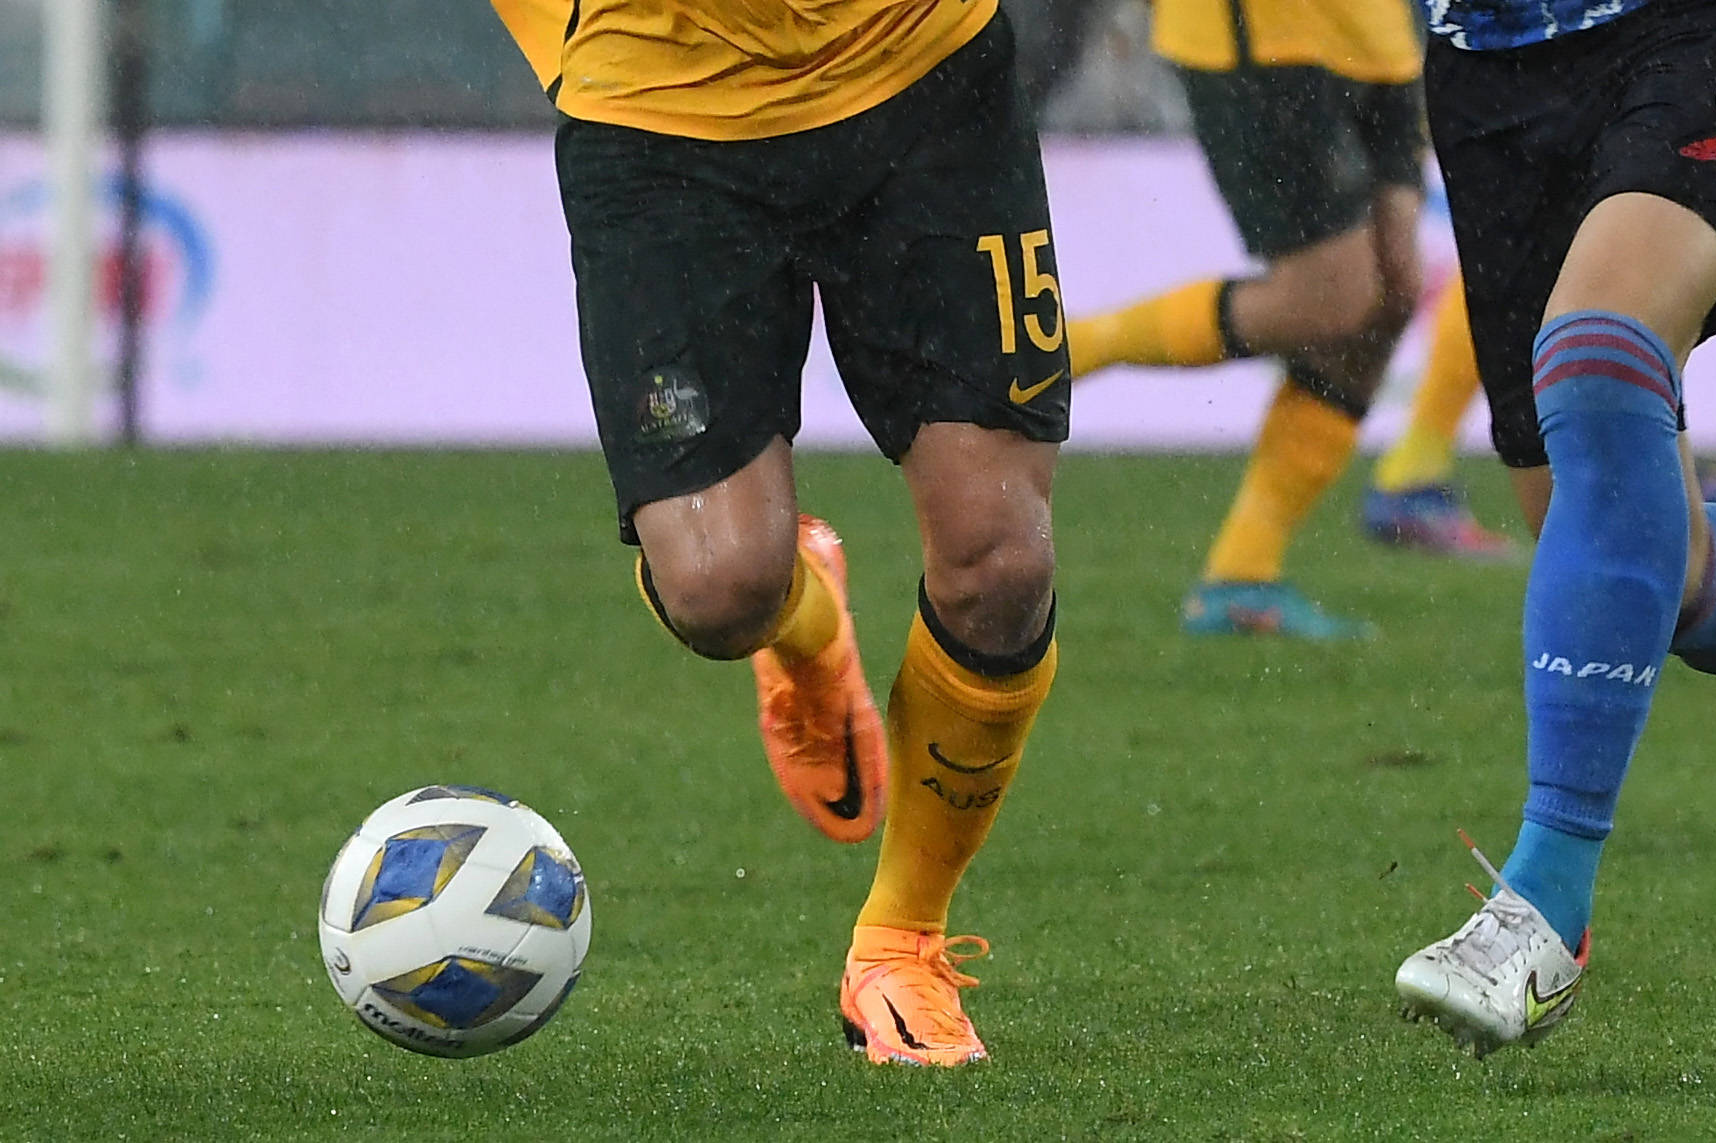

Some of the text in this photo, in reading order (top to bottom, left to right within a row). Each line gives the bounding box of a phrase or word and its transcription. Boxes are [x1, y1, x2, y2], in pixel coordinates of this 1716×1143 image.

[976, 229, 1063, 353] 15
[1532, 652, 1657, 687] JAPAN
[920, 777, 1002, 810] AUS
